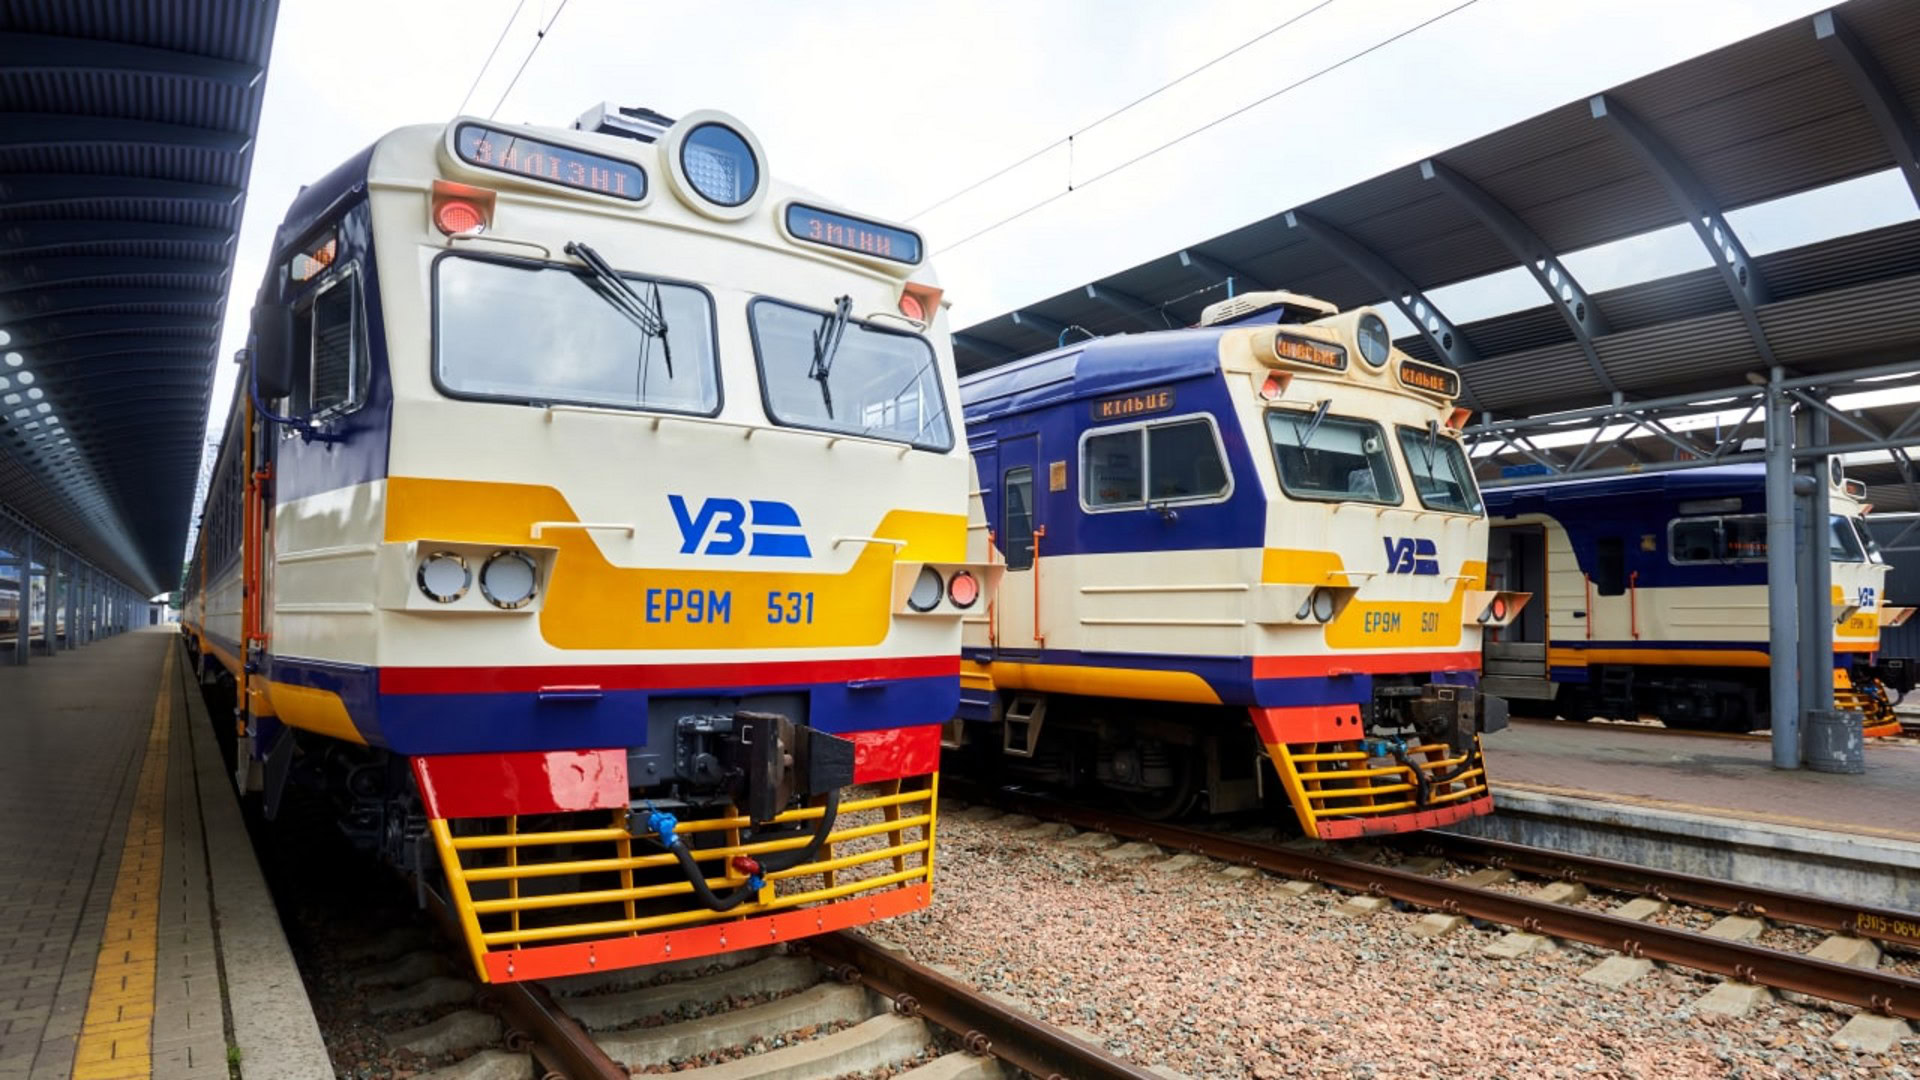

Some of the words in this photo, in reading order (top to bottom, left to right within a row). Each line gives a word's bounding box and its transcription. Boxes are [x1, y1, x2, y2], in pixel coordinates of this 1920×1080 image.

[473, 138, 628, 197] ЗАЛІЗНІ
[808, 218, 891, 257] ЗМІНИ
[1401, 366, 1446, 392] КІЛЬЦЕ
[1103, 392, 1169, 417] КІЛЬЦЕ
[667, 494, 747, 556] УЗ
[1383, 536, 1416, 574] УЗ
[645, 588, 732, 624] ЕР9М
[767, 591, 815, 625] 531
[1421, 611, 1440, 633] 501
